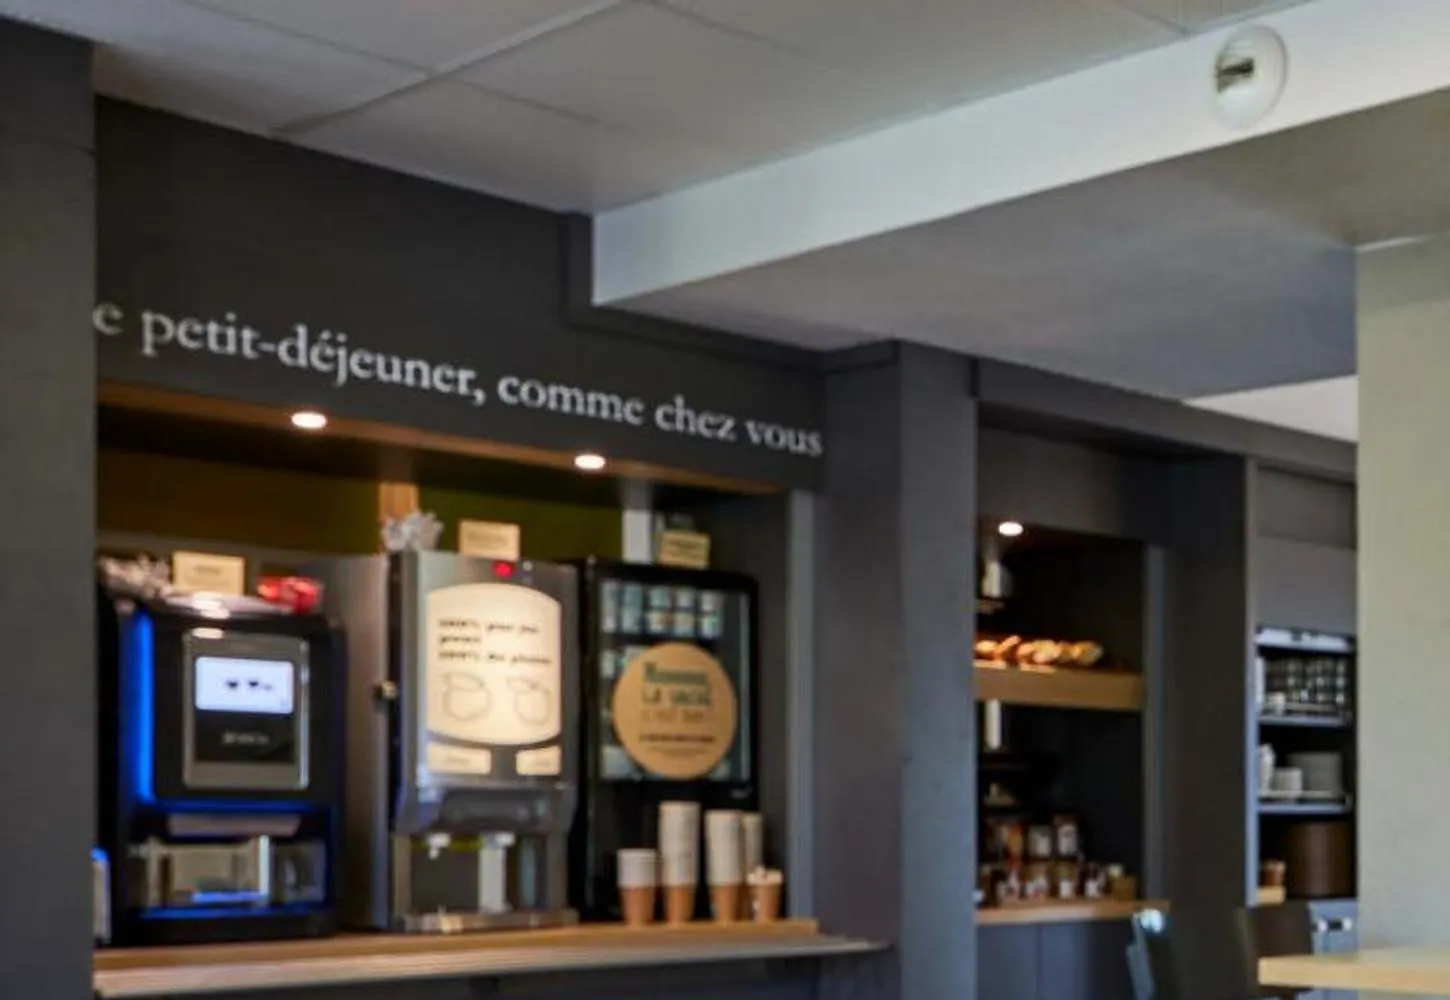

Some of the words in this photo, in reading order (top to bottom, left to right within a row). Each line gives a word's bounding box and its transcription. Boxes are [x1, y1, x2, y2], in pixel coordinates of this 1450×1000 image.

[92, 302, 125, 337] e
[140, 310, 487, 406] petit-déjeuner,
[497, 373, 646, 427] comme
[655, 394, 737, 443] chez
[744, 419, 823, 457] vous
